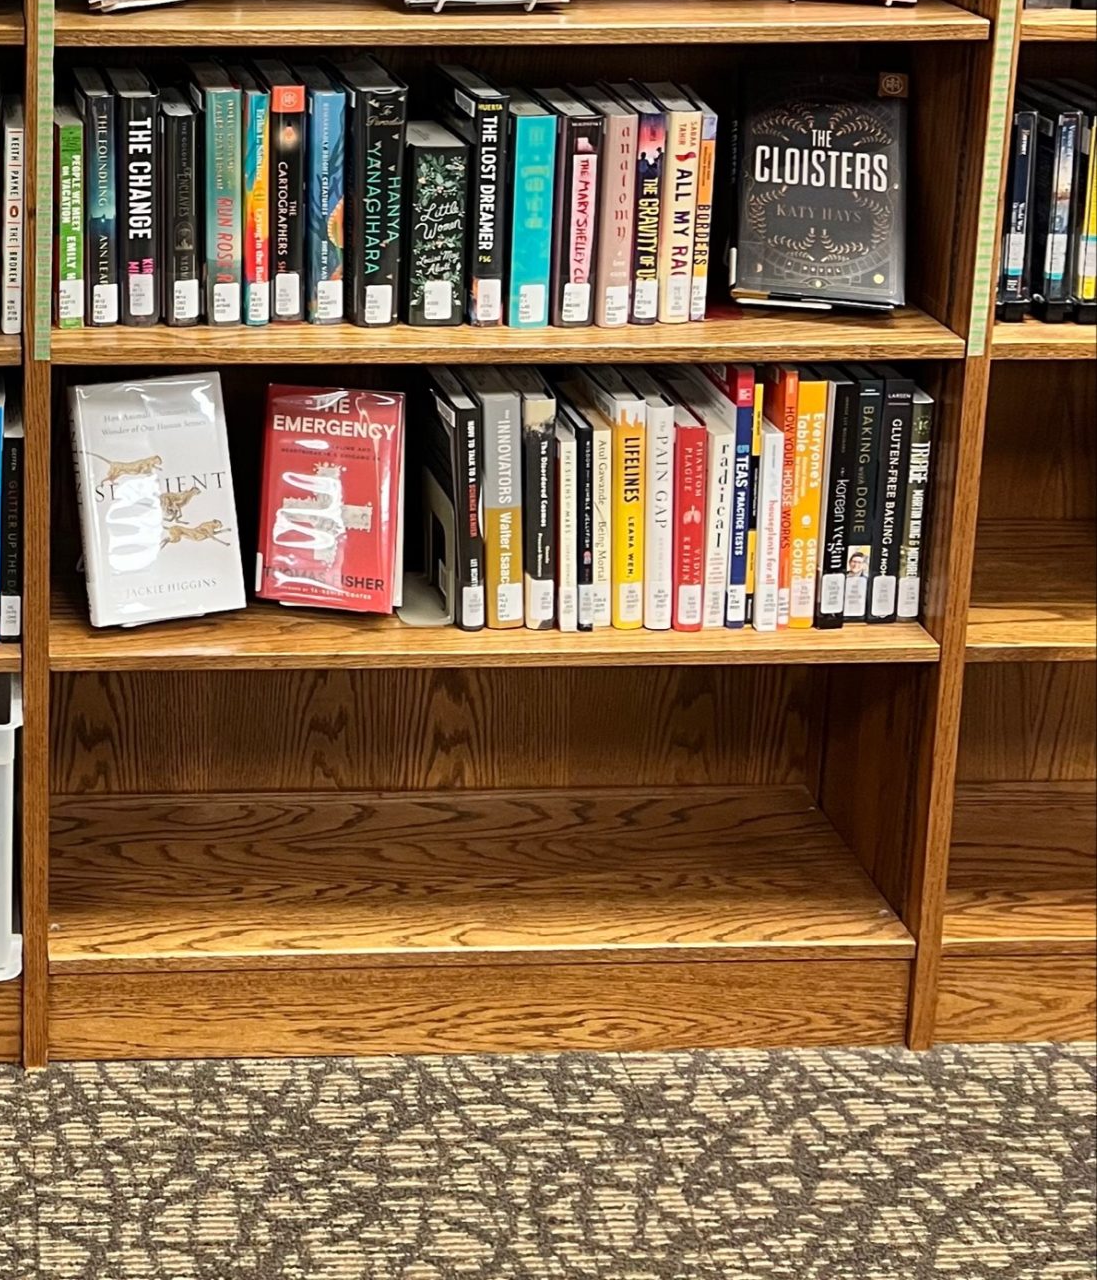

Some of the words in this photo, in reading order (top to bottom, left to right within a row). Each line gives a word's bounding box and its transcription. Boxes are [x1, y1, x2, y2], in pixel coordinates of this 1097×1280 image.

[128, 118, 152, 154] THE
[482, 116, 497, 143] THE
[812, 129, 832, 148] THE
[480, 146, 496, 180] LOST
[755, 145, 888, 192] CLOISTERS
[128, 162, 152, 239] CHANGE
[364, 140, 382, 275] YANAGIHARA
[420, 202, 462, 222] Little
[478, 184, 495, 250] DREAMER
[414, 219, 464, 241] Women
[273, 415, 396, 440] EMERGENCY
[497, 420, 513, 504] INNOVATORS
[624, 437, 640, 503] LIFELINES
